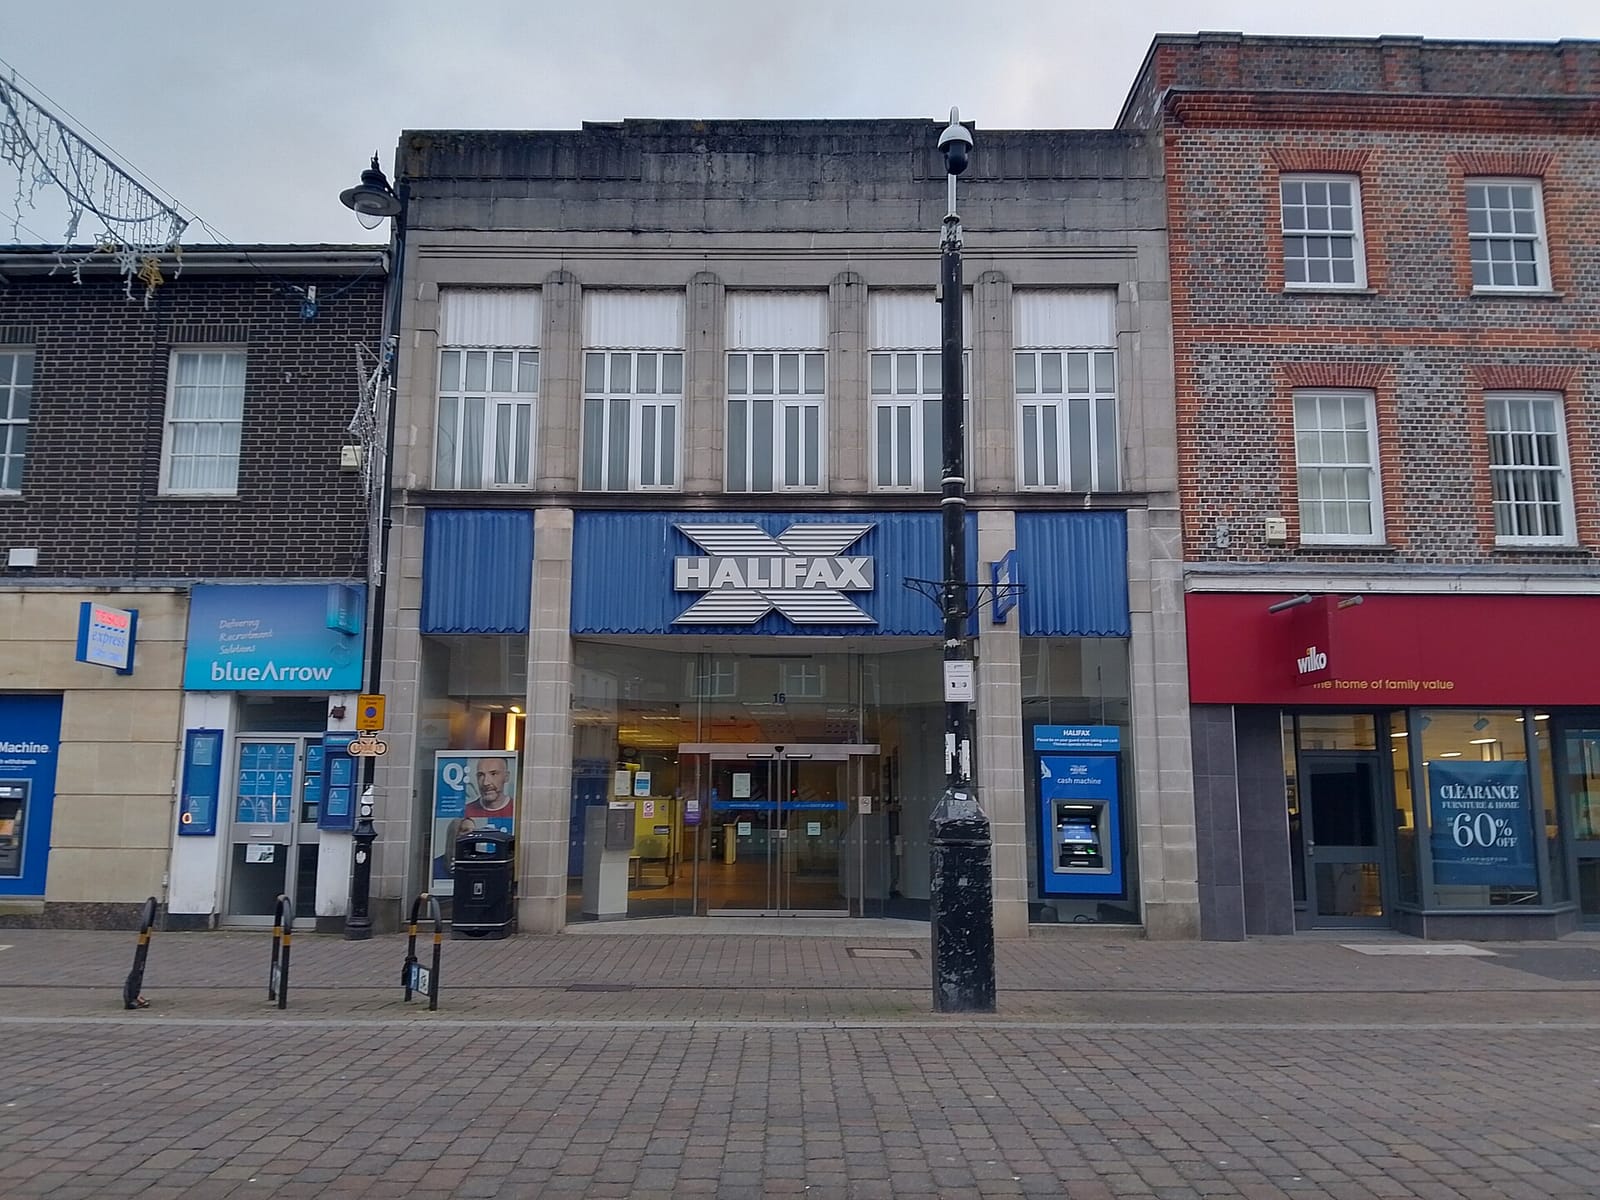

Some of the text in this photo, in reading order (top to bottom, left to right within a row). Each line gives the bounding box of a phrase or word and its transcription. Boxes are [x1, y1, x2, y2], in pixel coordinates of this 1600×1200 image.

[676, 557, 873, 588] HALIFAX
[95, 609, 129, 629] TESCO
[219, 618, 260, 631] Delivering
[92, 629, 127, 648] express
[1297, 646, 1328, 674] wilko
[211, 660, 334, 682] blueArrow
[1335, 679, 1368, 689] home
[1370, 679, 1383, 689] of
[1385, 679, 1419, 691] family
[1422, 679, 1454, 689] value
[773, 692, 786, 704] 16
[0, 741, 49, 753] Machine
[442, 763, 470, 791] Q:
[1440, 785, 1520, 799] CLEARANCE
[1442, 801, 1486, 809] FURNITURE
[1496, 837, 1518, 847] OFF
